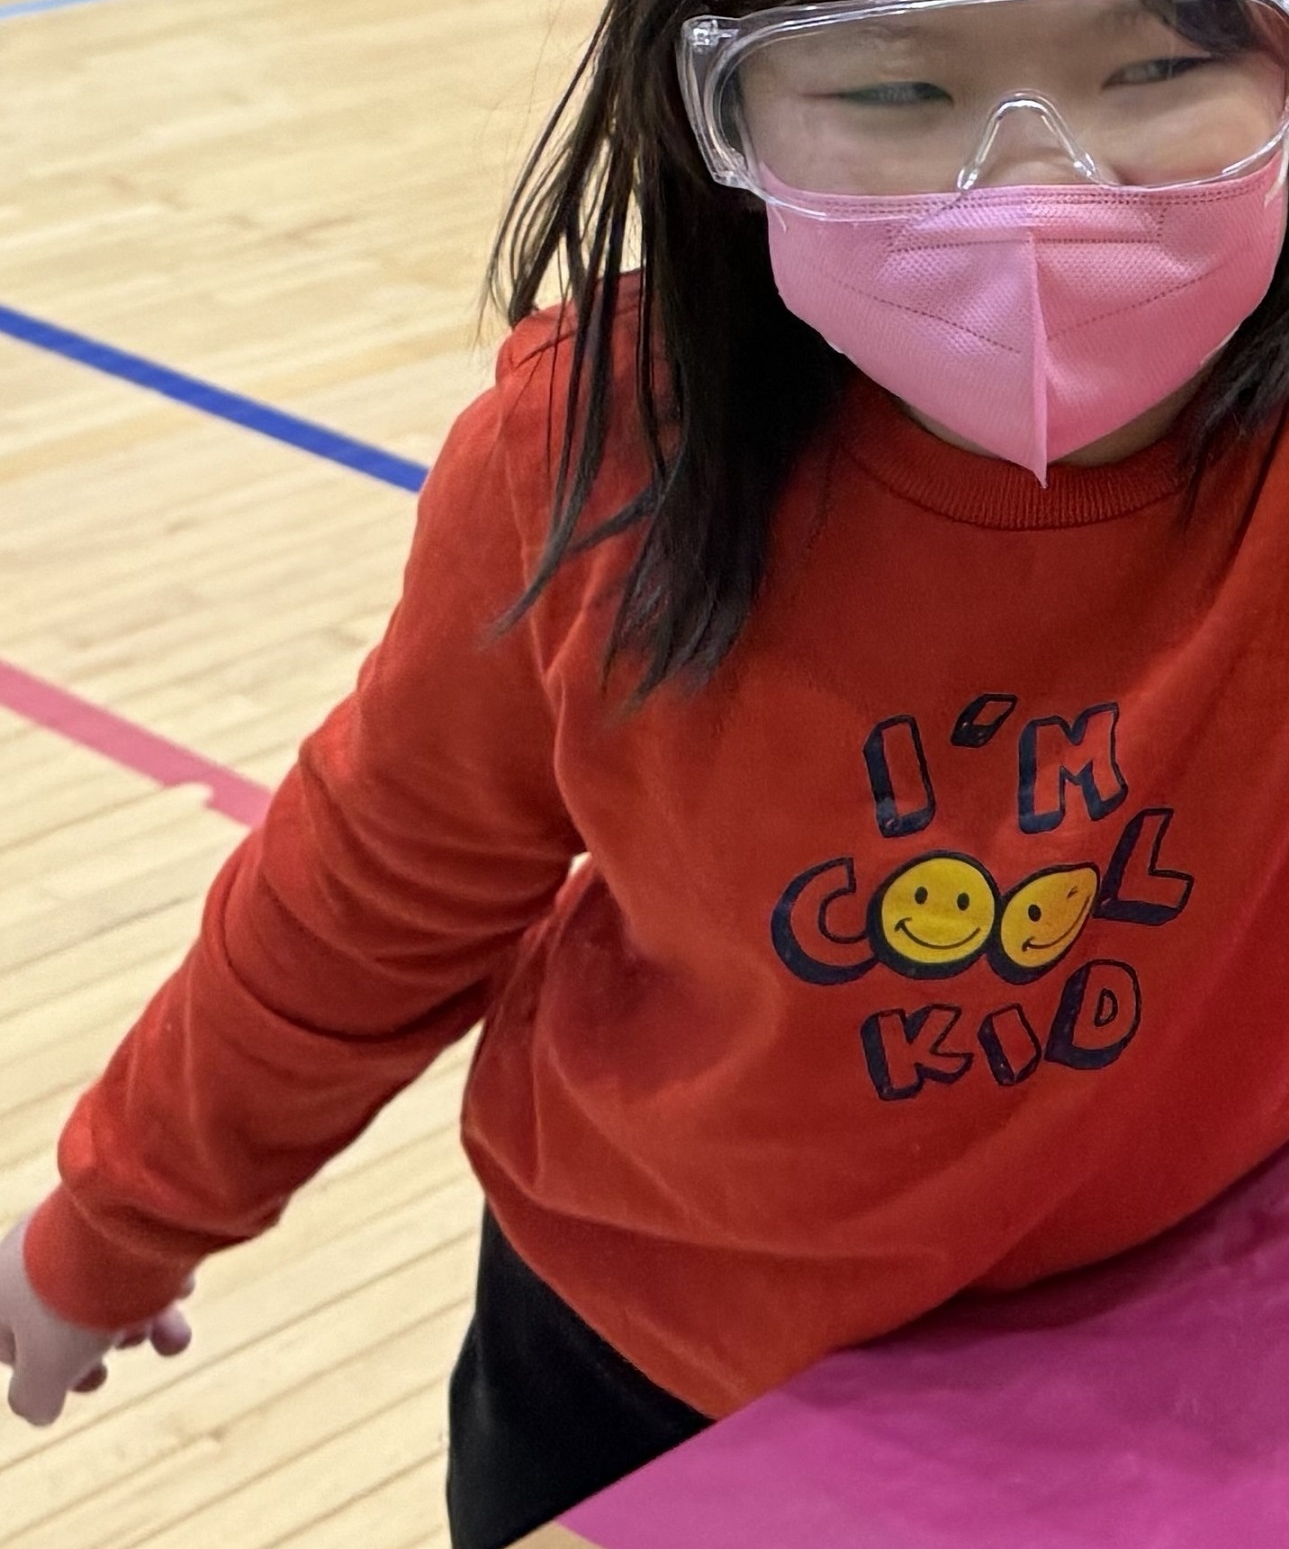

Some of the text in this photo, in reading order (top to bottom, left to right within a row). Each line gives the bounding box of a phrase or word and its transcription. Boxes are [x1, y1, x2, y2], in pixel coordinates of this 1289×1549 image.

[863, 692, 1128, 838] I'M
[771, 807, 1194, 986] COOL
[860, 959, 1142, 1101] KID
